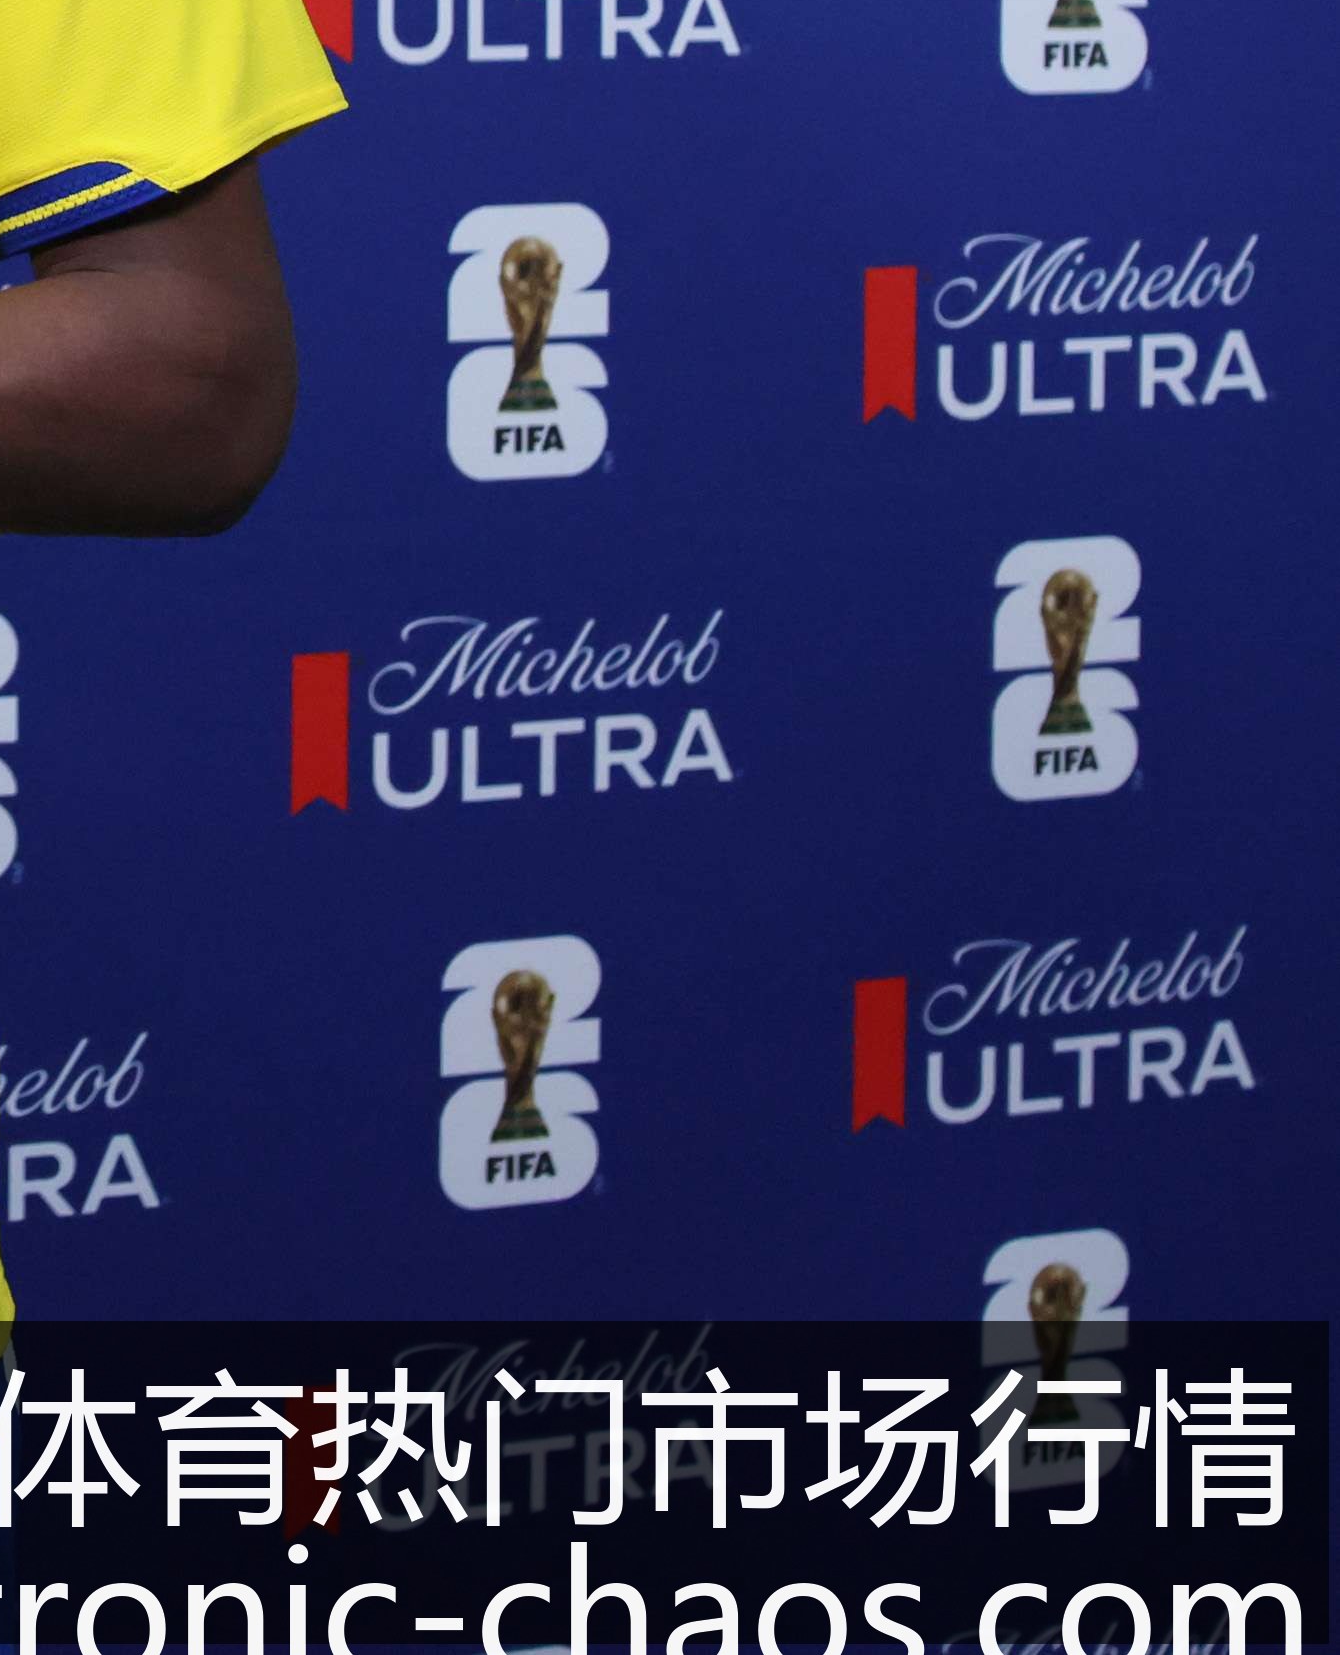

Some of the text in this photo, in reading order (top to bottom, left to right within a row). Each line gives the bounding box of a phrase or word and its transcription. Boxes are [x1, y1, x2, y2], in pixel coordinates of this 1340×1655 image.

[1043, 42, 1108, 68] FIFA
[934, 234, 1258, 329] Michelob
[938, 330, 1267, 420] ULTRA
[494, 424, 565, 455] FIFA
[369, 609, 723, 715] Michelob
[373, 709, 733, 809] ULTRA
[1034, 746, 1098, 776] FIFA
[924, 926, 1246, 1035] Michelob
[927, 1019, 1255, 1123] ULTRA
[485, 1151, 556, 1184] FIFA
